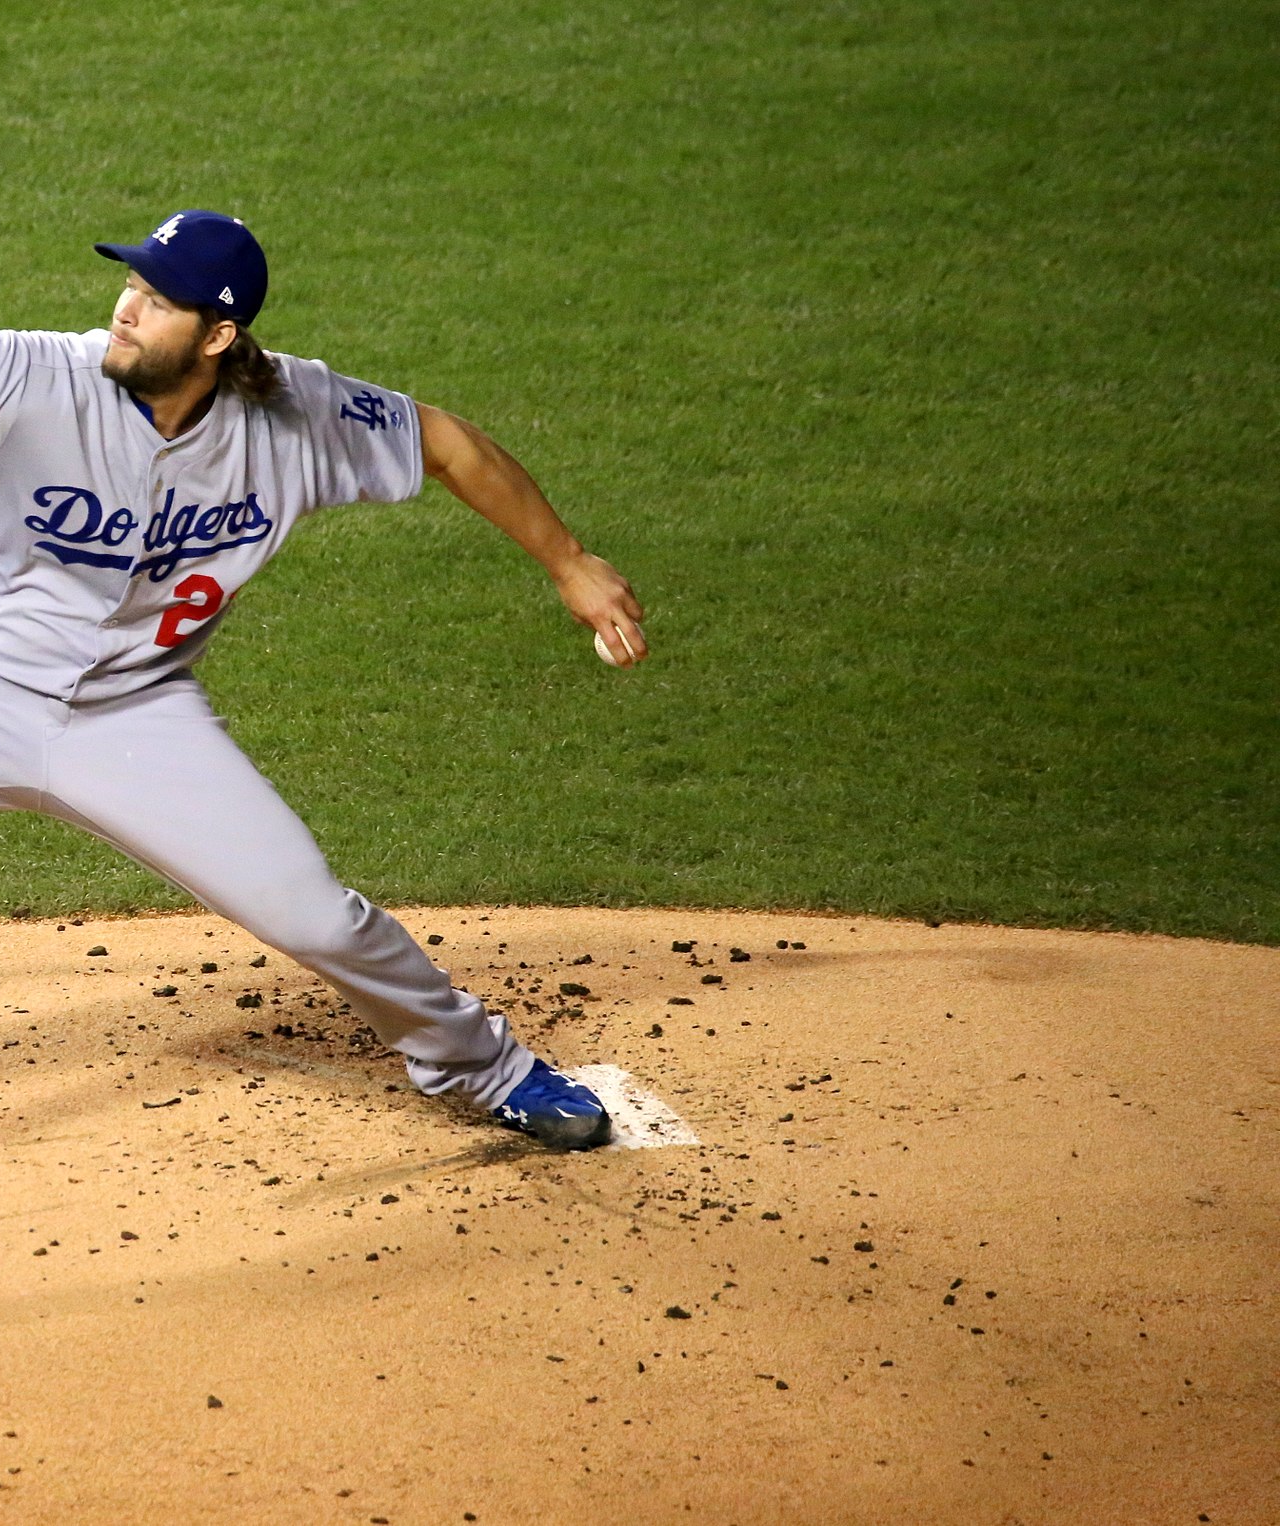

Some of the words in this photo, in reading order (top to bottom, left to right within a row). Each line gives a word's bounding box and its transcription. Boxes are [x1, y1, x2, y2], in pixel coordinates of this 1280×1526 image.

[152, 213, 185, 245] LA
[340, 390, 386, 431] LA
[24, 486, 273, 583] Dodgers
[154, 574, 237, 648] 2
